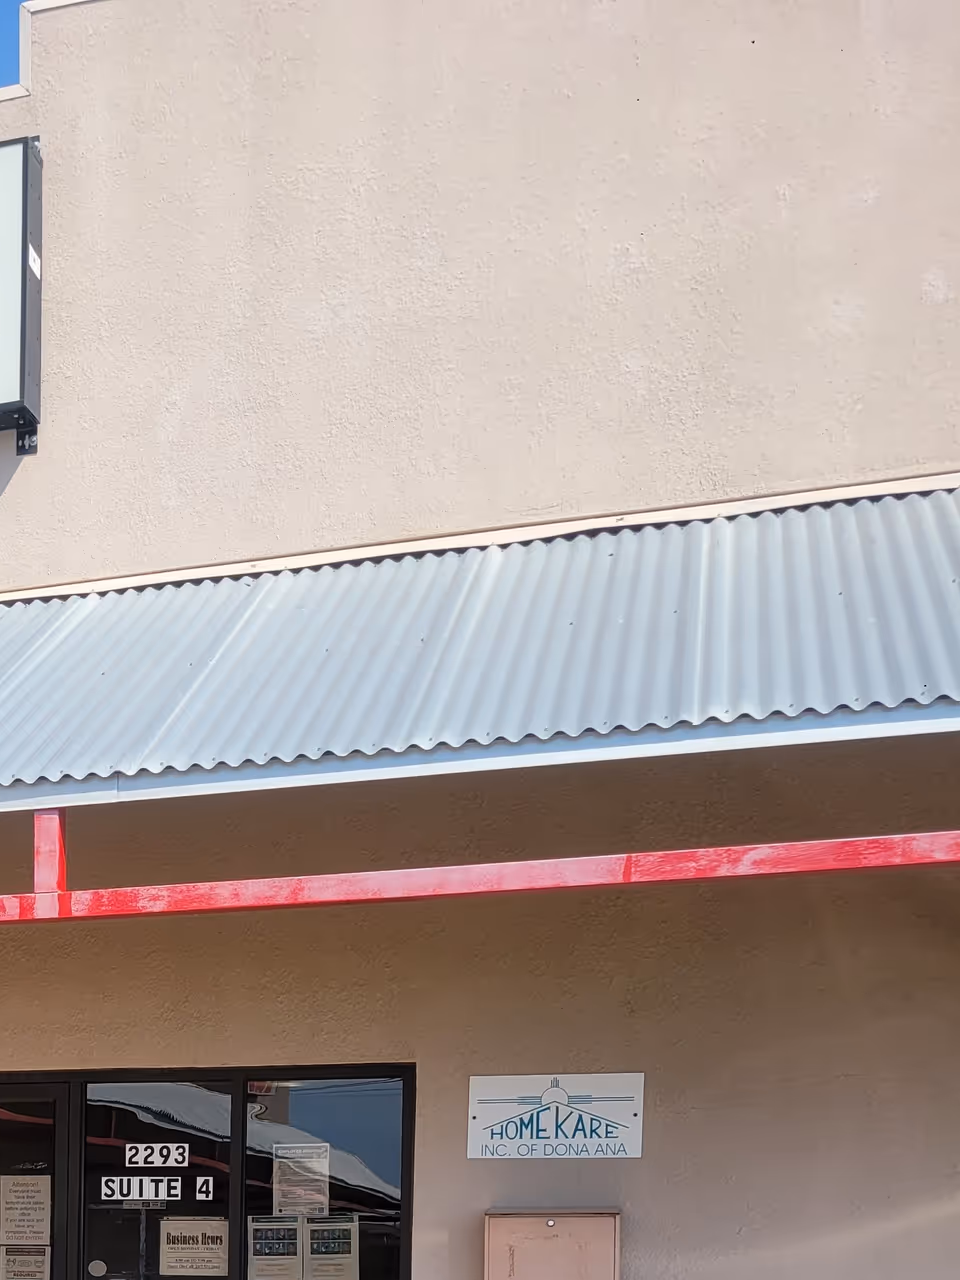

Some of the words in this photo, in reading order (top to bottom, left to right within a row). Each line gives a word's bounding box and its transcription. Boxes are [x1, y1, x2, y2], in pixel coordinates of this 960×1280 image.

[127, 1145, 186, 1165] 2293
[481, 1143, 511, 1157] INC.
[517, 1143, 538, 1157] OF
[543, 1143, 590, 1157] DONA
[594, 1142, 628, 1156] ANA
[103, 1178, 179, 1198] SUITE
[197, 1178, 211, 1199] 4
[166, 1232, 200, 1246] Business
[201, 1232, 223, 1246] Hours
